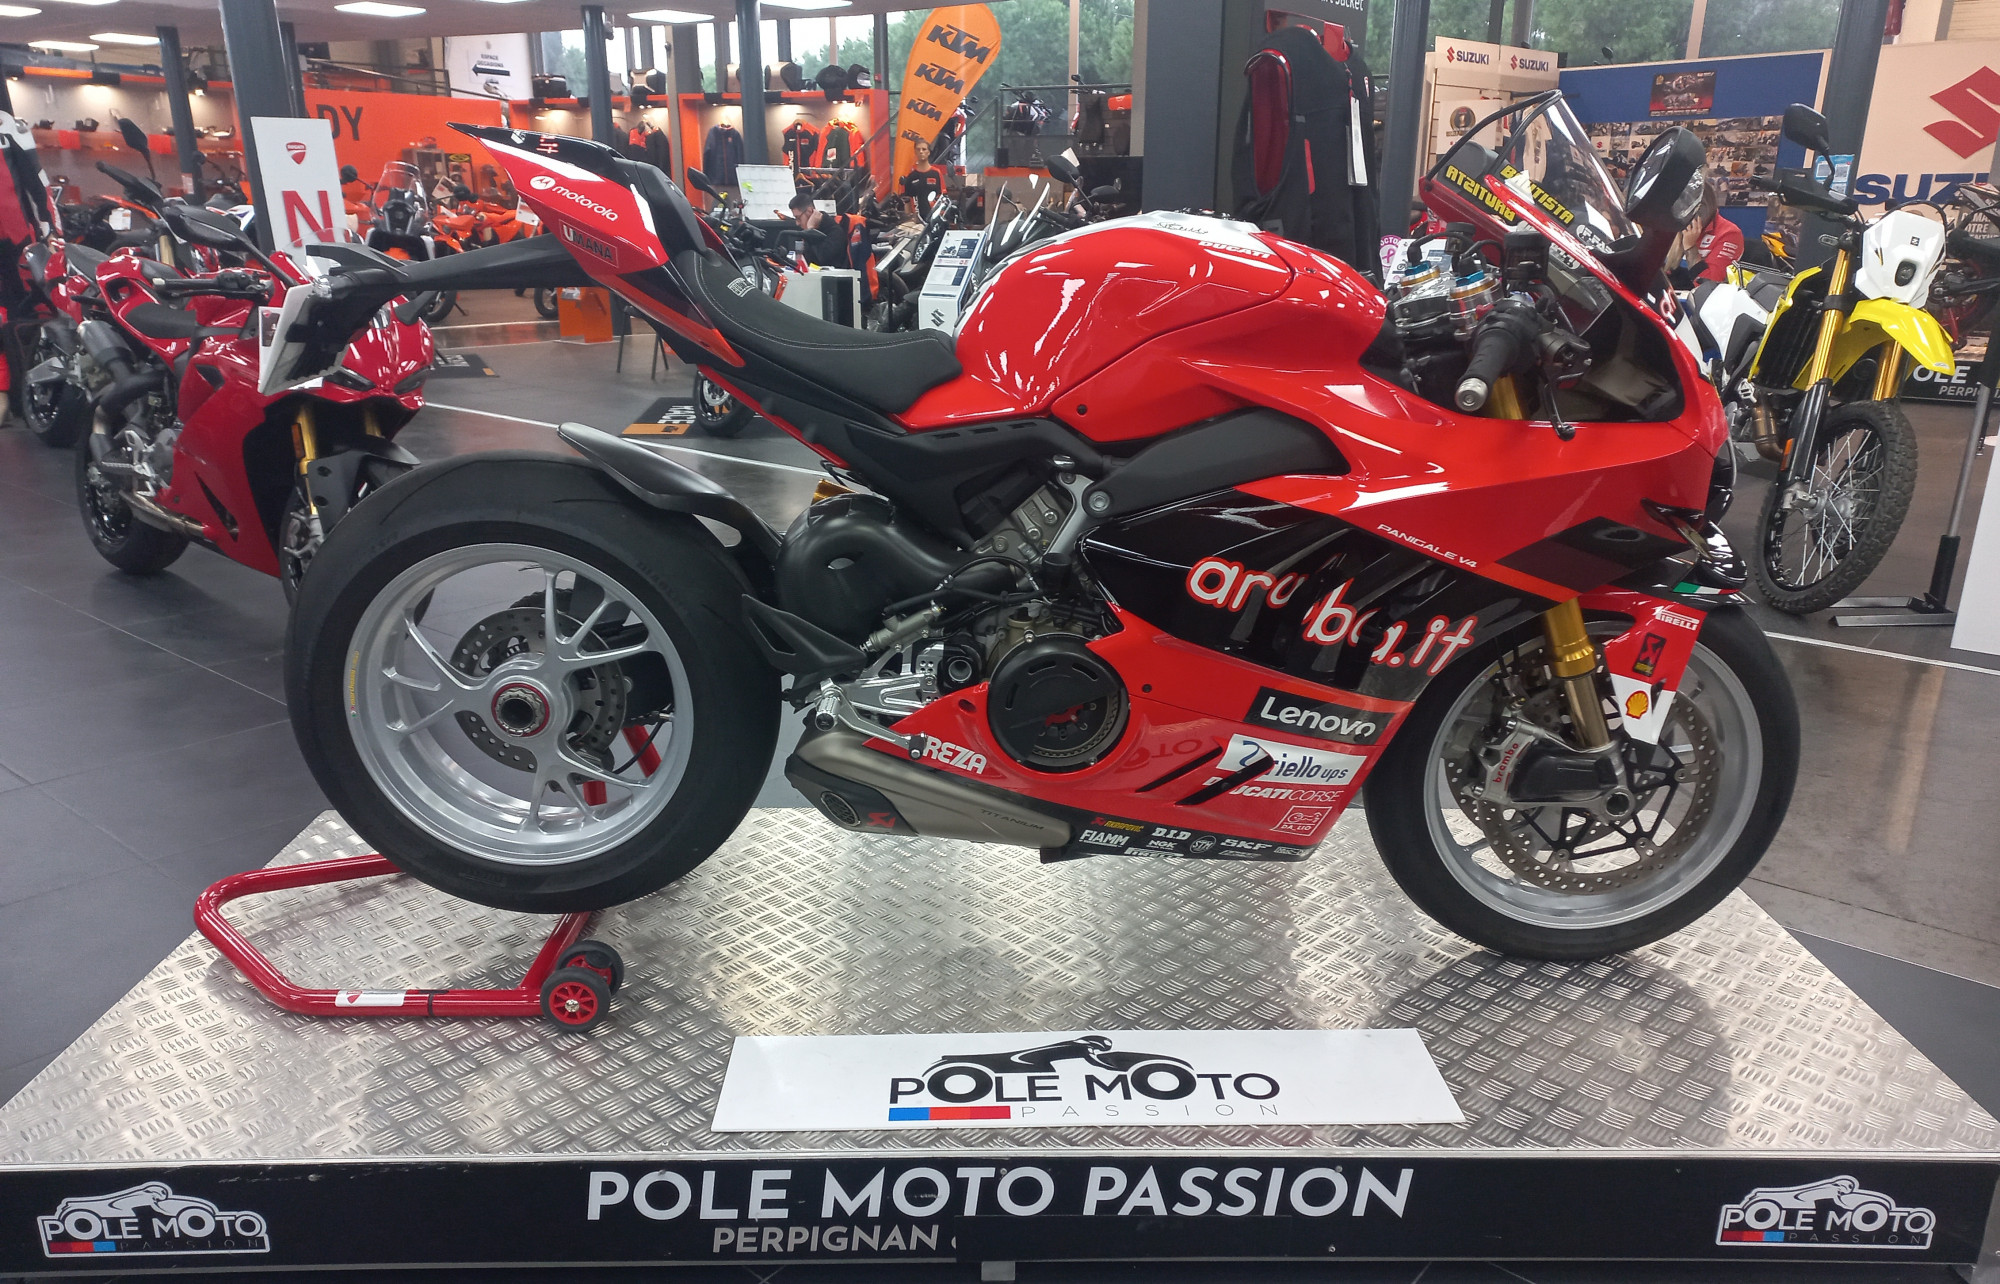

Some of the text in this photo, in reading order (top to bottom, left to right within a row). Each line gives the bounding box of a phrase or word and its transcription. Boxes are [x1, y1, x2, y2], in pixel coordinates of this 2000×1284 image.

[927, 24, 991, 64] KTM
[1456, 50, 1489, 65] SUZUKI
[1519, 58, 1549, 72] SUZUKI
[914, 62, 964, 94] KTM
[906, 98, 942, 121] KTM
[316, 104, 363, 141] DY
[552, 185, 619, 222] motorola
[1964, 223, 1990, 233] OTRE
[562, 224, 615, 262] UMANA
[1198, 240, 1271, 259] DUCATI
[1912, 365, 1971, 384] OLE
[1377, 523, 1478, 569] PANIGALE V4
[1652, 605, 1700, 631] PIRELLI
[1260, 696, 1376, 741] Lenovo
[1266, 753, 1348, 783] iello ups
[1492, 742, 1519, 784] brembo
[981, 808, 1045, 831] TITANIUM
[1080, 829, 1130, 846] FIAMM
[1148, 840, 1178, 849] NGK
[1151, 827, 1191, 841] D.I.D
[1192, 840, 1214, 850] STM
[1220, 839, 1272, 850] SKF
[889, 1063, 1281, 1104] POLE MOTO
[1022, 1103, 1279, 1119] PASSION
[587, 1165, 1415, 1221] POLE MOTO PASSION
[43, 1207, 262, 1241] POLE MOTO
[1724, 1201, 1930, 1233] POLE MOTO
[120, 1239, 259, 1251] PASSION
[712, 1224, 940, 1253] PERPIGNAN
[1788, 1232, 1921, 1245] PASSION
